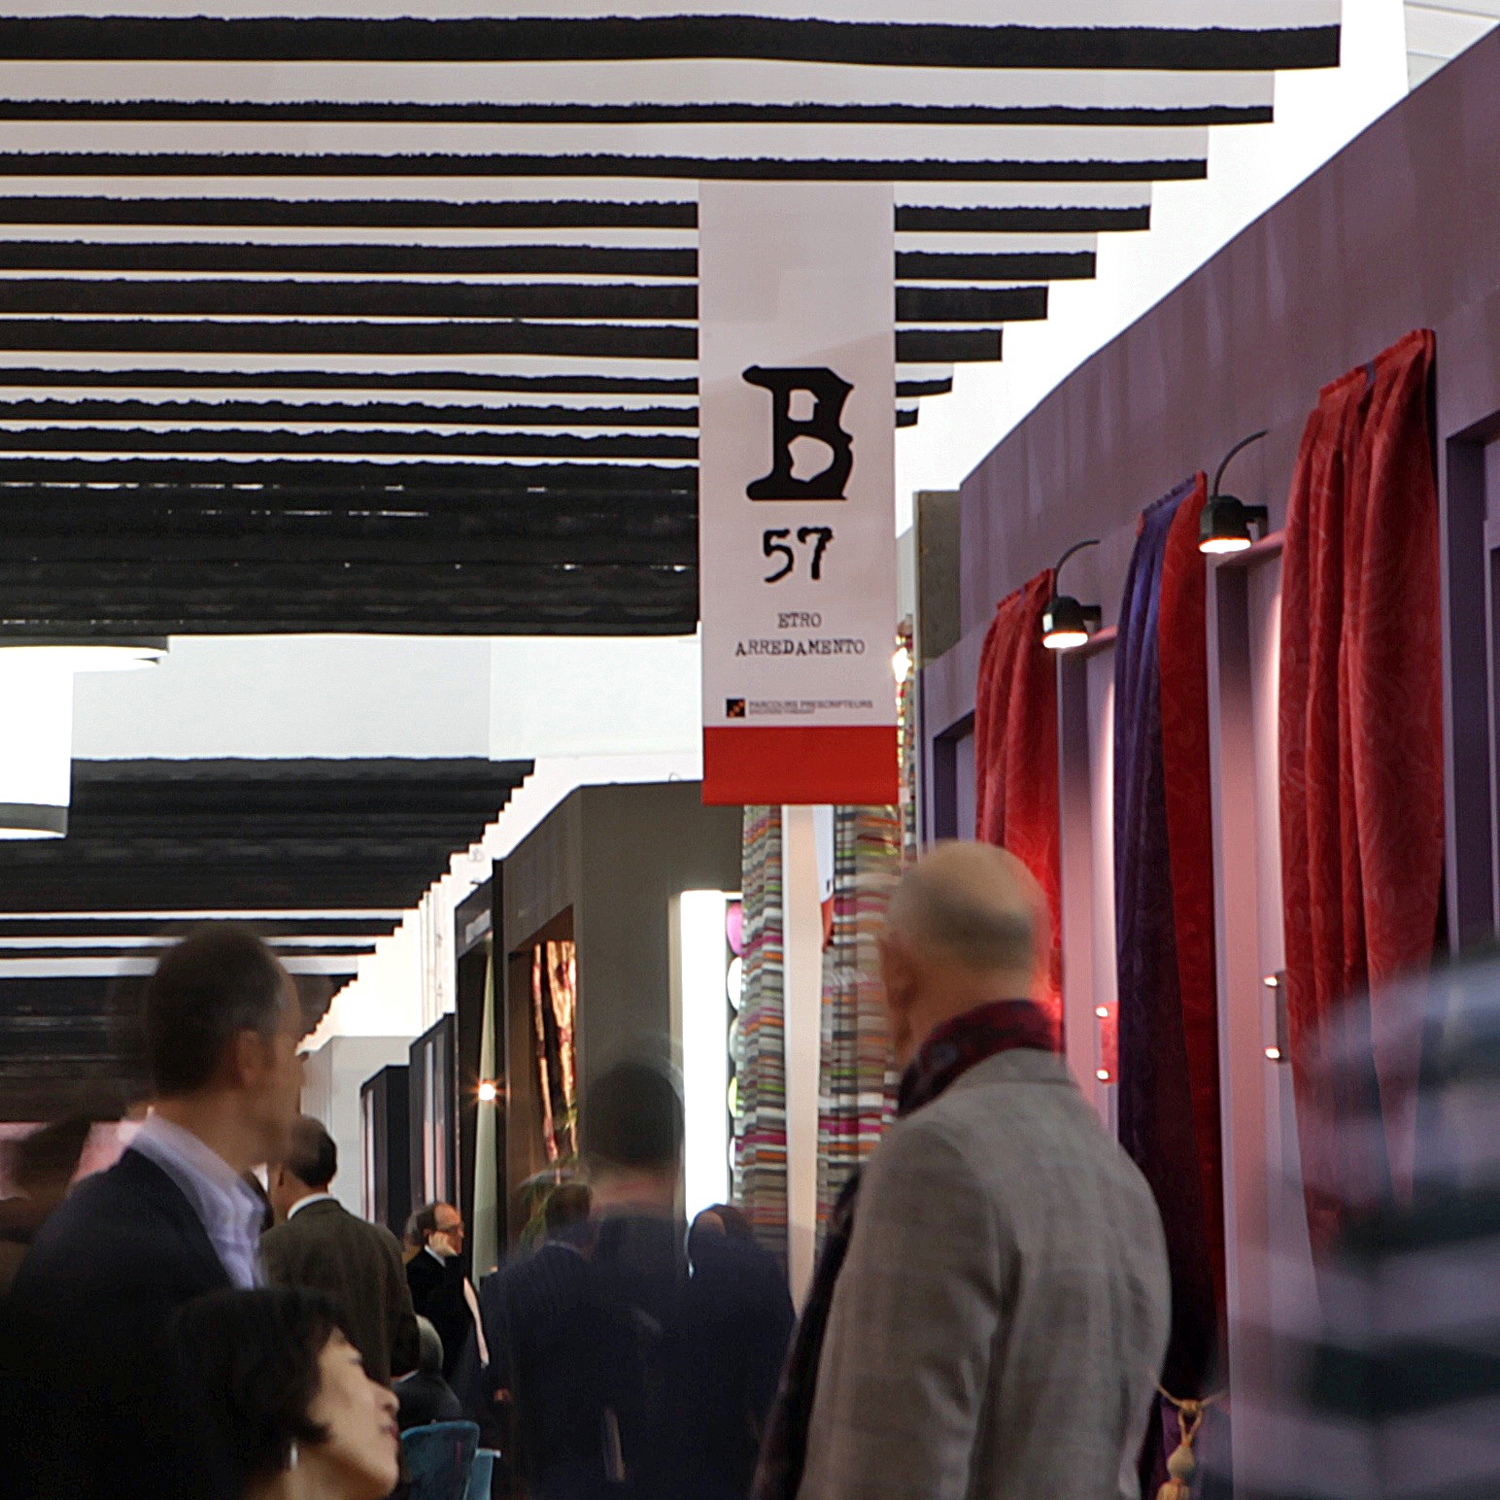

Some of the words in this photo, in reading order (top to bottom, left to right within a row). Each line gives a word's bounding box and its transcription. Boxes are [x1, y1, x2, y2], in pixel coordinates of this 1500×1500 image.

[741, 365, 854, 501] B
[762, 527, 833, 583] 57
[777, 612, 822, 629] ETRO
[735, 638, 866, 657] ARREDAMENTO
